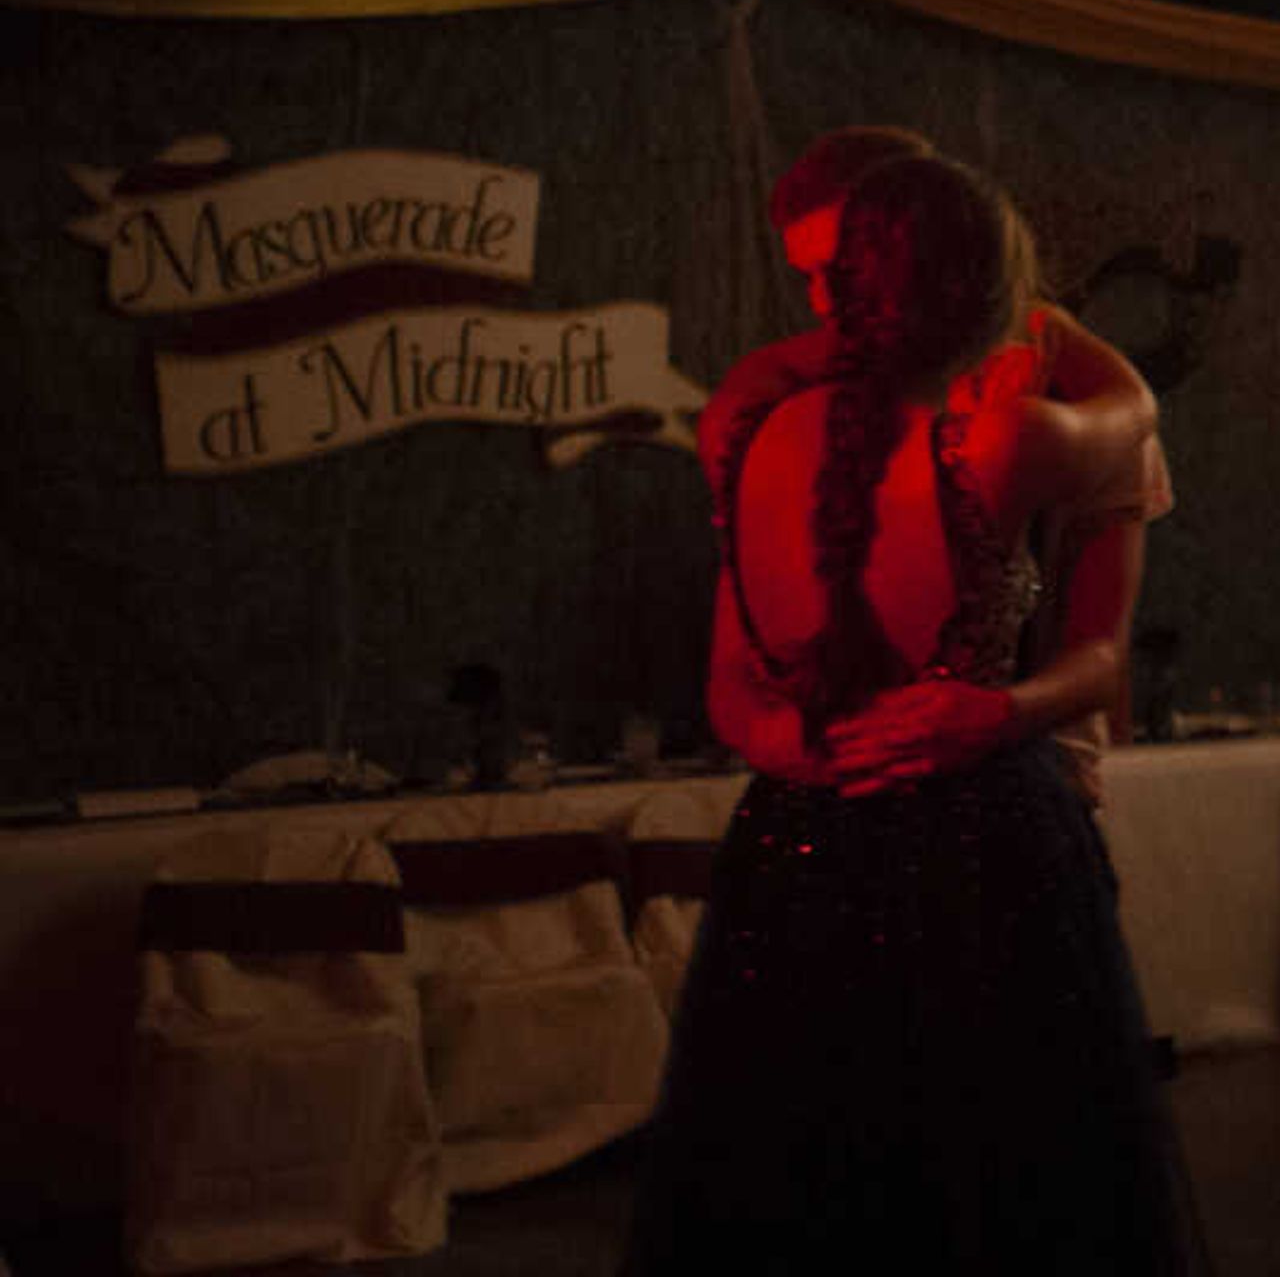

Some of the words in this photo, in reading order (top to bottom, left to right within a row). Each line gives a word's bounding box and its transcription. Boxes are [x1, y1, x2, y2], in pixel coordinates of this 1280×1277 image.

[118, 175, 514, 302] Masquerade
[200, 374, 266, 462] at
[301, 318, 613, 442] Midnight
